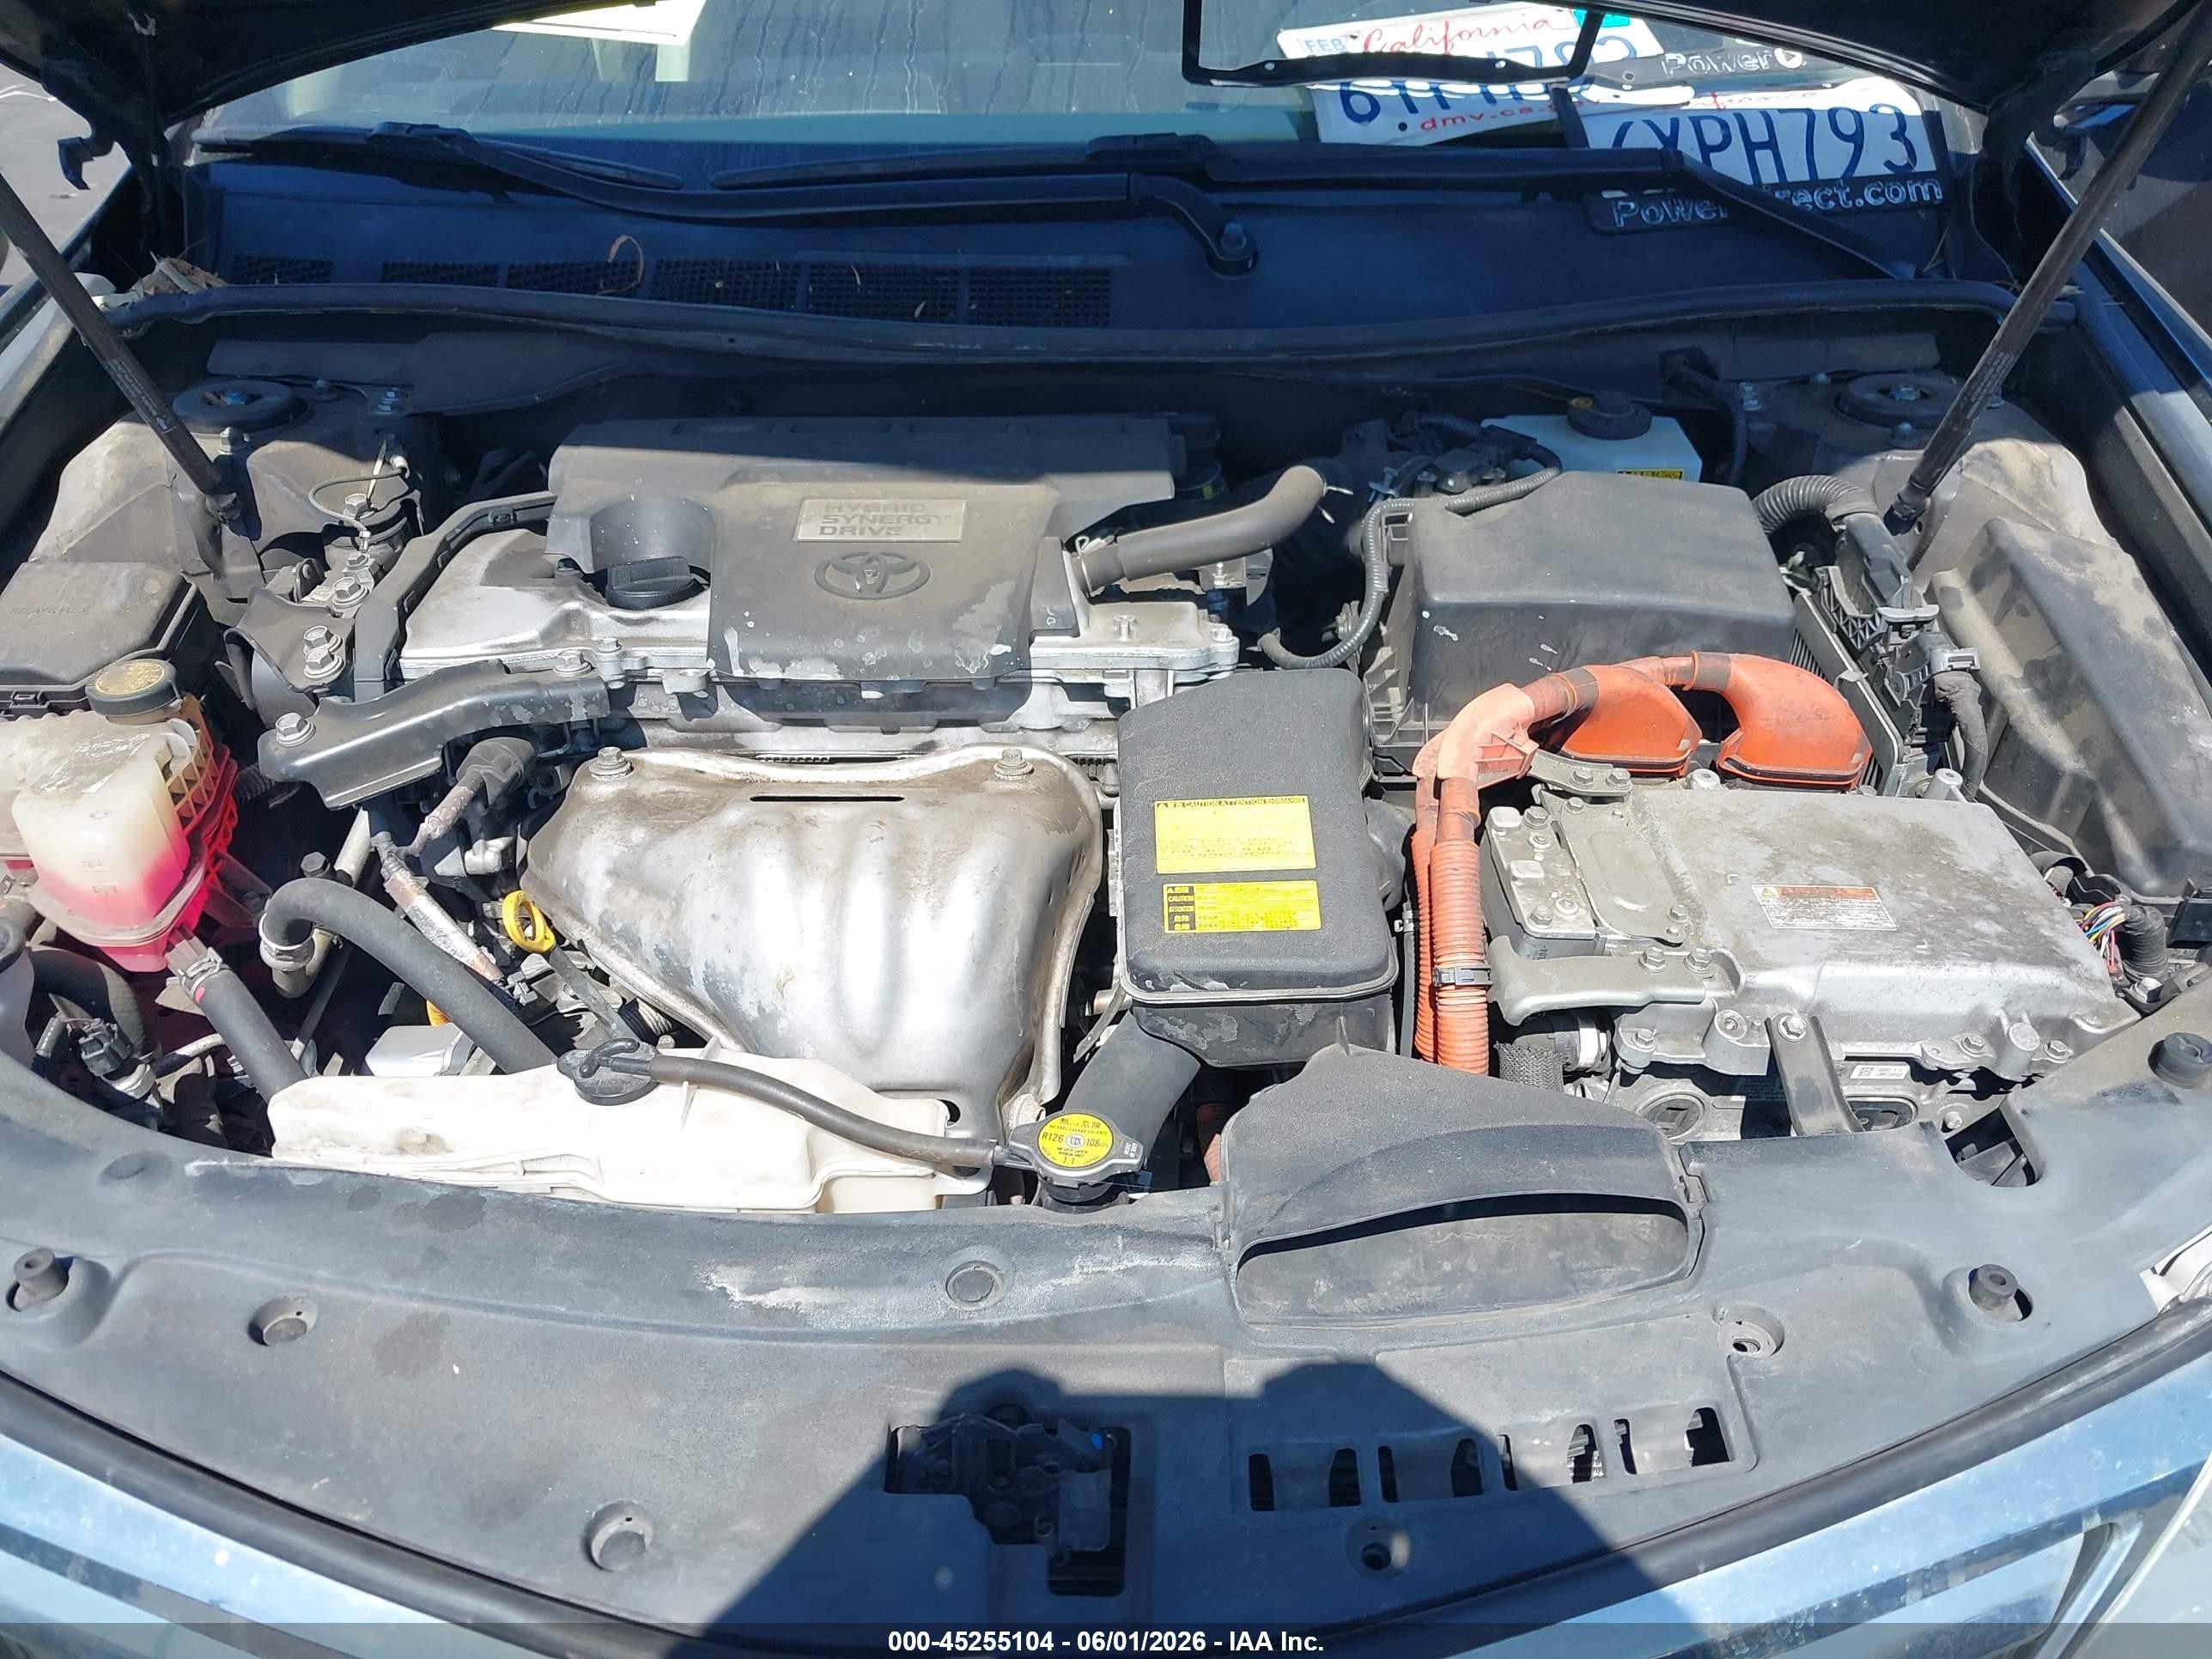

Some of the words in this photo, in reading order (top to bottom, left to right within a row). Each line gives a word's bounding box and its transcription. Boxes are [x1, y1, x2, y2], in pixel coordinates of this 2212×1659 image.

[1304, 37, 1346, 53] FEB
[1362, 19, 1566, 55] California
[1662, 49, 1771, 78] Power
[1420, 98, 1601, 131] dmv.ca.
[1612, 177, 1943, 228] Powerrect.com
[824, 503, 926, 513] HYBRID
[819, 526, 902, 536] DRIVE
[1042, 1132, 1065, 1143] R126
